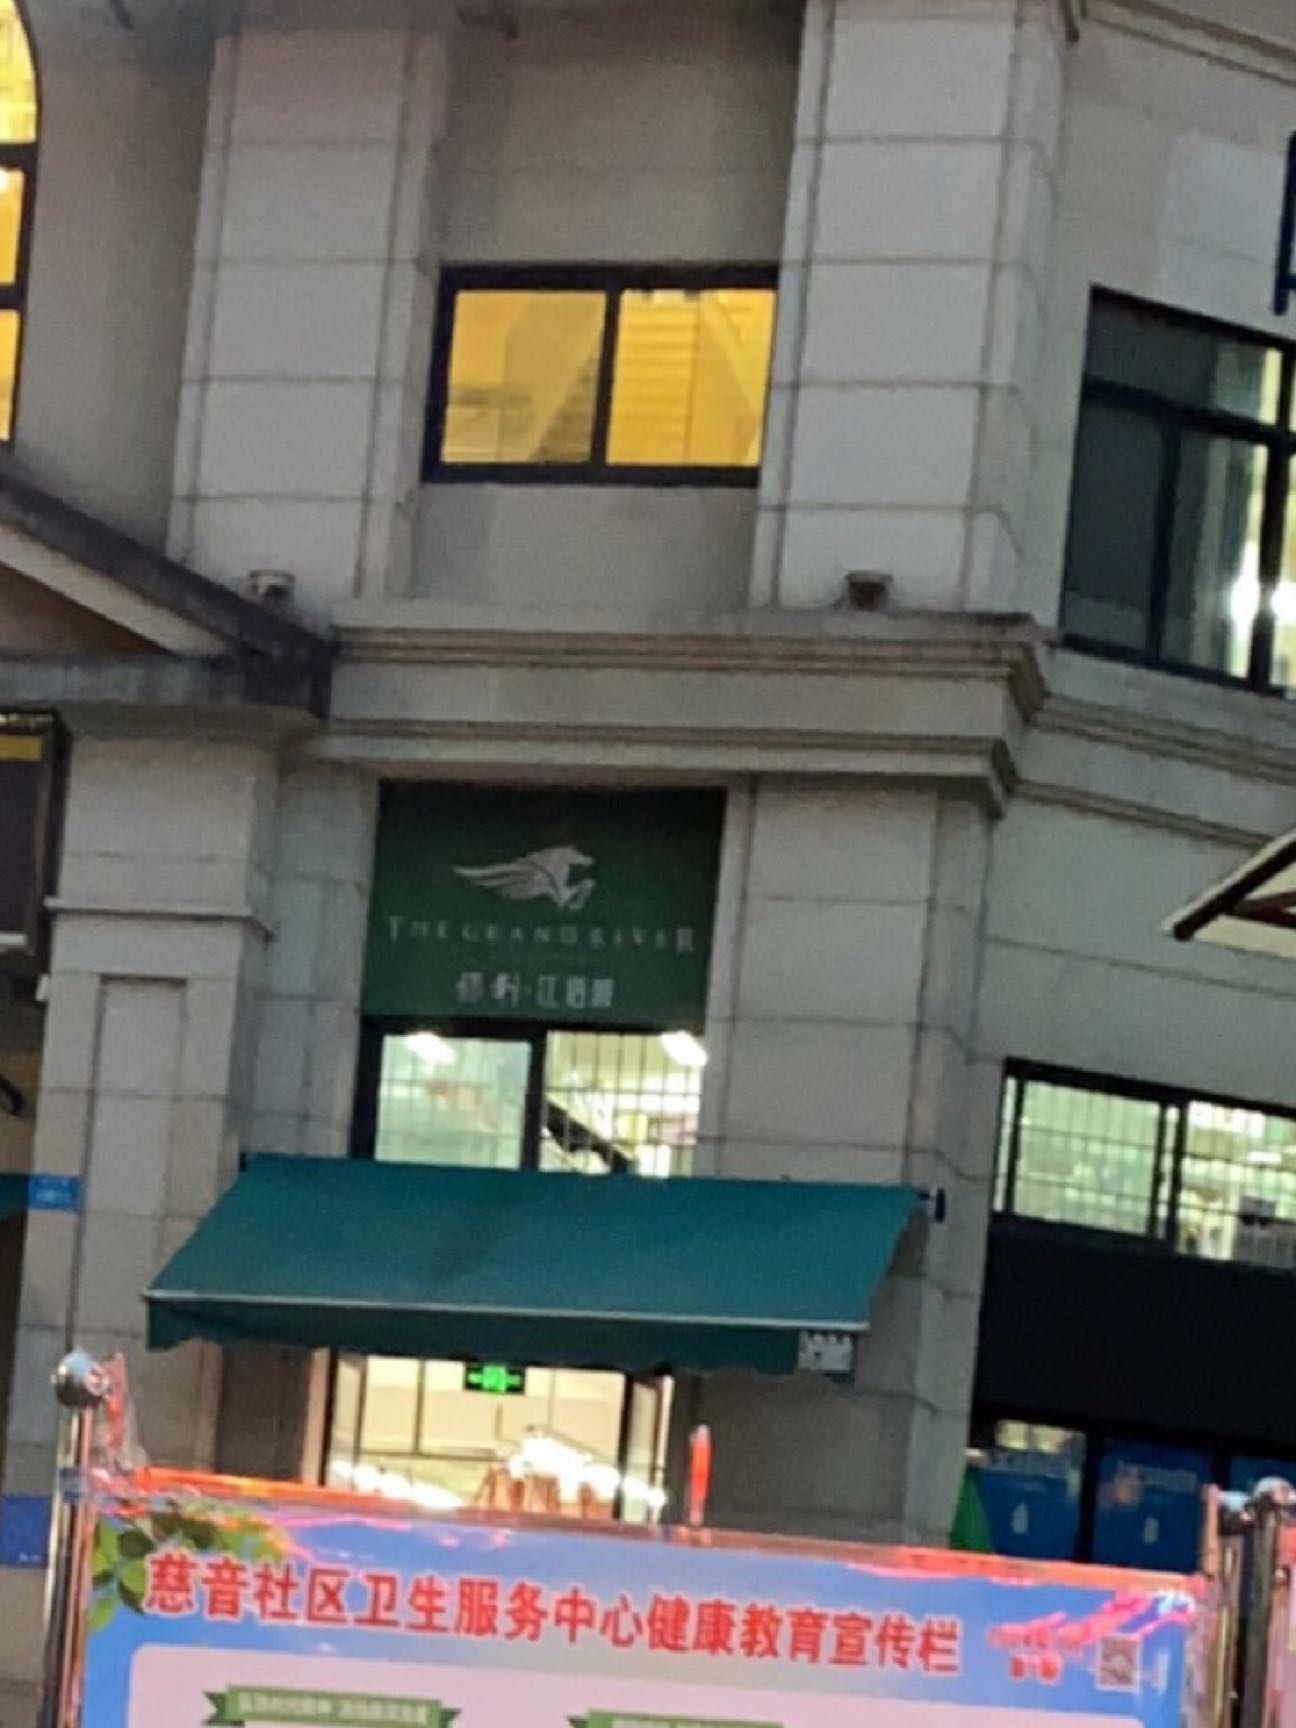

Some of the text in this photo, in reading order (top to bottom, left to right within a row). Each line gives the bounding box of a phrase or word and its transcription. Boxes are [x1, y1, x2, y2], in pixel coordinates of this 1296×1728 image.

[147, 1551, 960, 1674] 慈音社区卫生服务中心健康教育宣传栏
